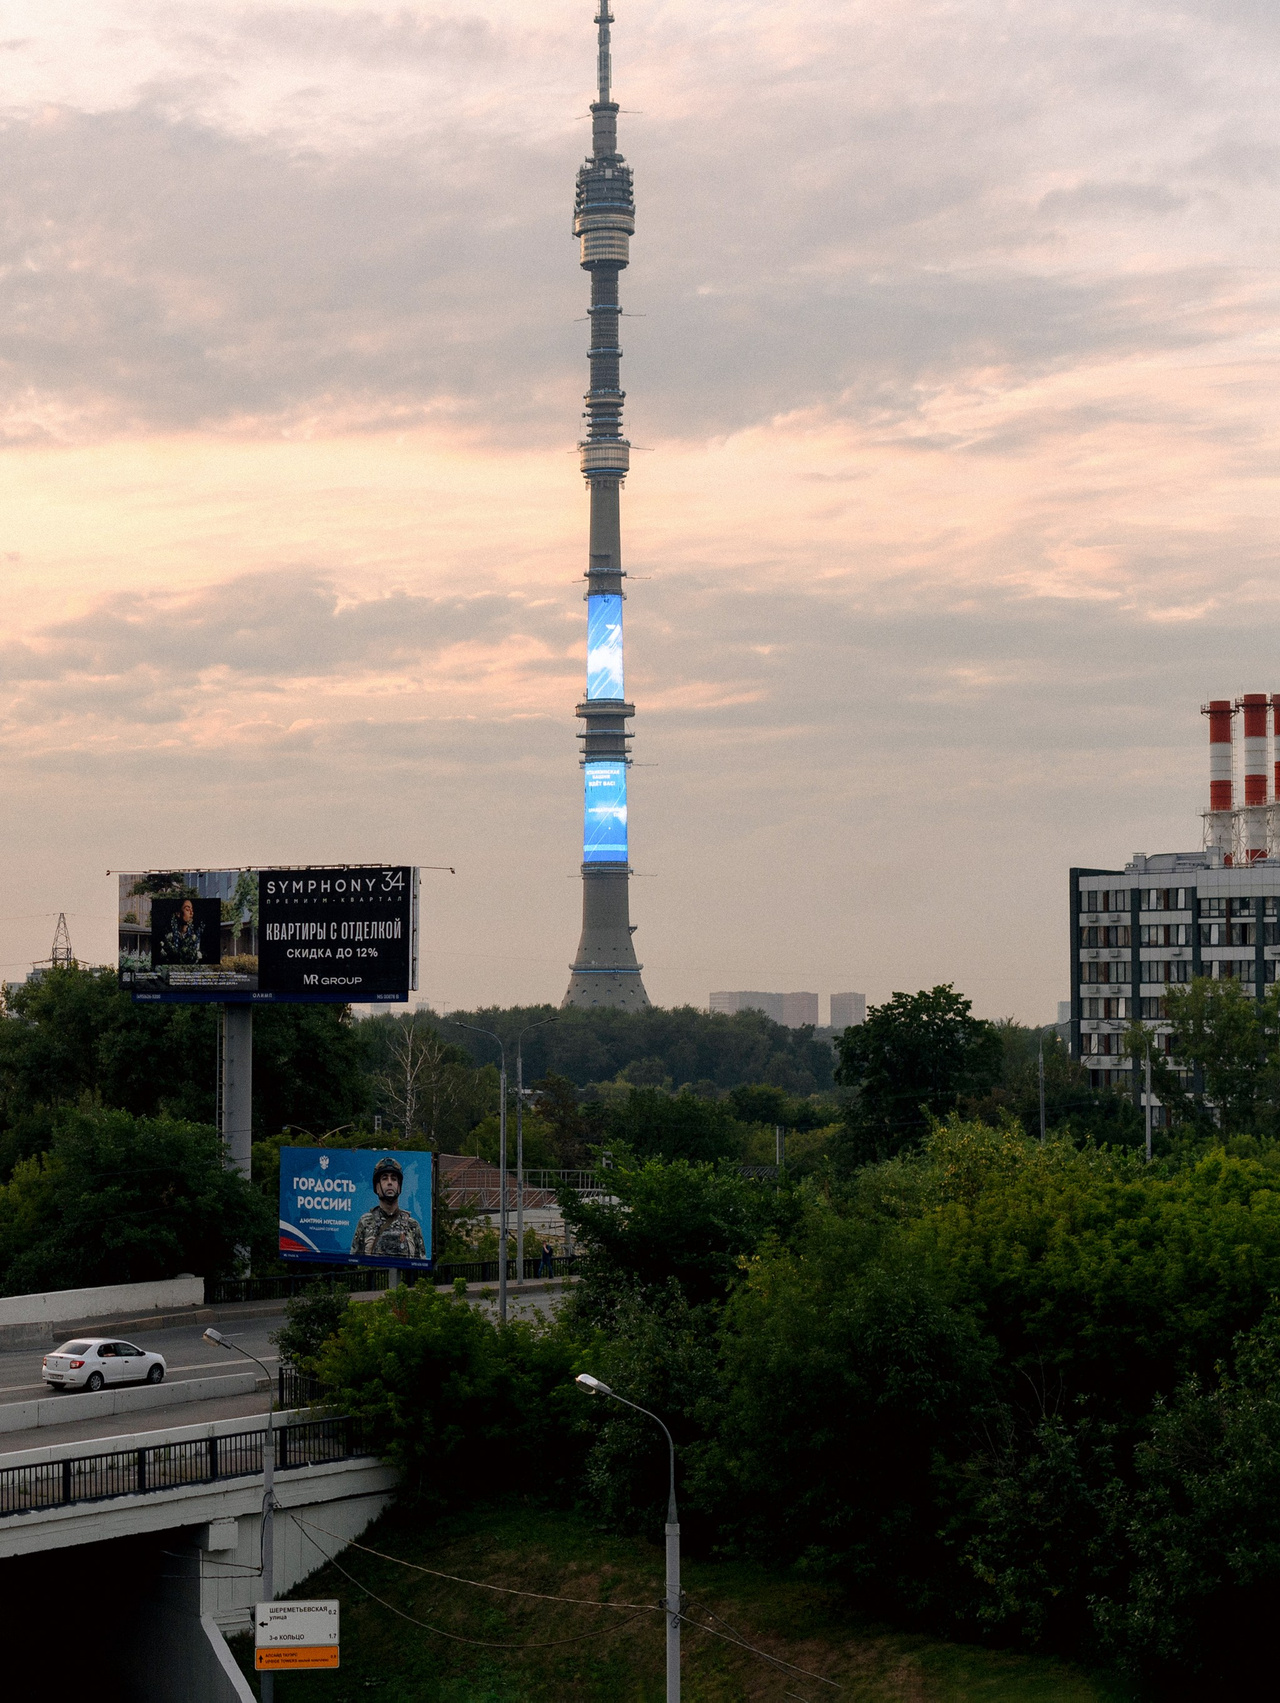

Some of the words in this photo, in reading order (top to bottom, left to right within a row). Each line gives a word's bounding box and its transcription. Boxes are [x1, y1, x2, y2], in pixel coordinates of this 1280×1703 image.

[267, 878, 376, 894] SYMPHONY
[381, 871, 406, 891] 34
[266, 896, 402, 904] ПРЕМИУМ-КВАРТАЛ
[266, 922, 326, 940] КВАРТИРЫ
[330, 922, 337, 940] С
[341, 918, 402, 941] ОТДЕЛКОЙ
[286, 948, 332, 959] СКИДКА
[336, 948, 353, 959] ДО
[356, 948, 379, 957] 12%
[303, 974, 319, 985] MR
[321, 977, 363, 985] GROUP
[293, 1177, 356, 1193] ГОРДОСТЬ
[297, 1196, 352, 1211] РОССИИ!
[269, 1606, 328, 1614] ШЕРЕМЕТЬЕВСКАЯ
[279, 1633, 305, 1641] КОЛЬЦО
